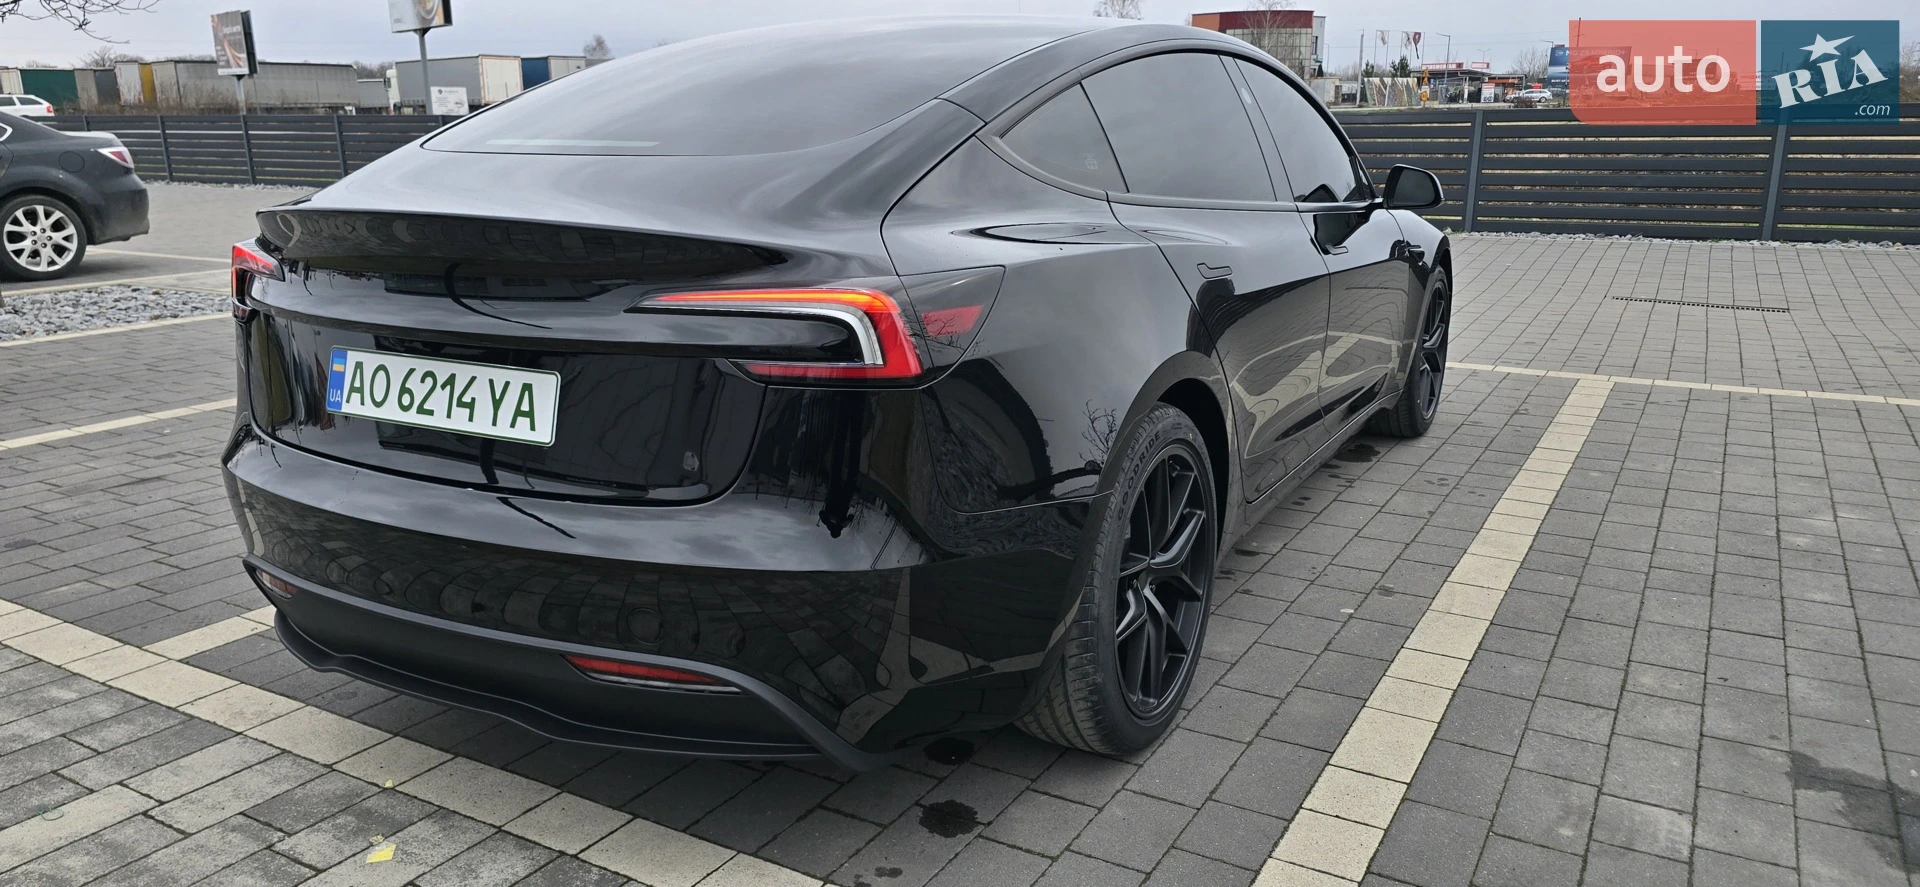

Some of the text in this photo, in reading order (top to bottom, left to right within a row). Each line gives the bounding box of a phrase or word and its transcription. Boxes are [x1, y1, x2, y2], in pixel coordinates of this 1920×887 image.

[330, 392, 342, 403] UA
[346, 361, 537, 432] AO 6214 YA
[1118, 430, 1161, 521] GOODRIDE
